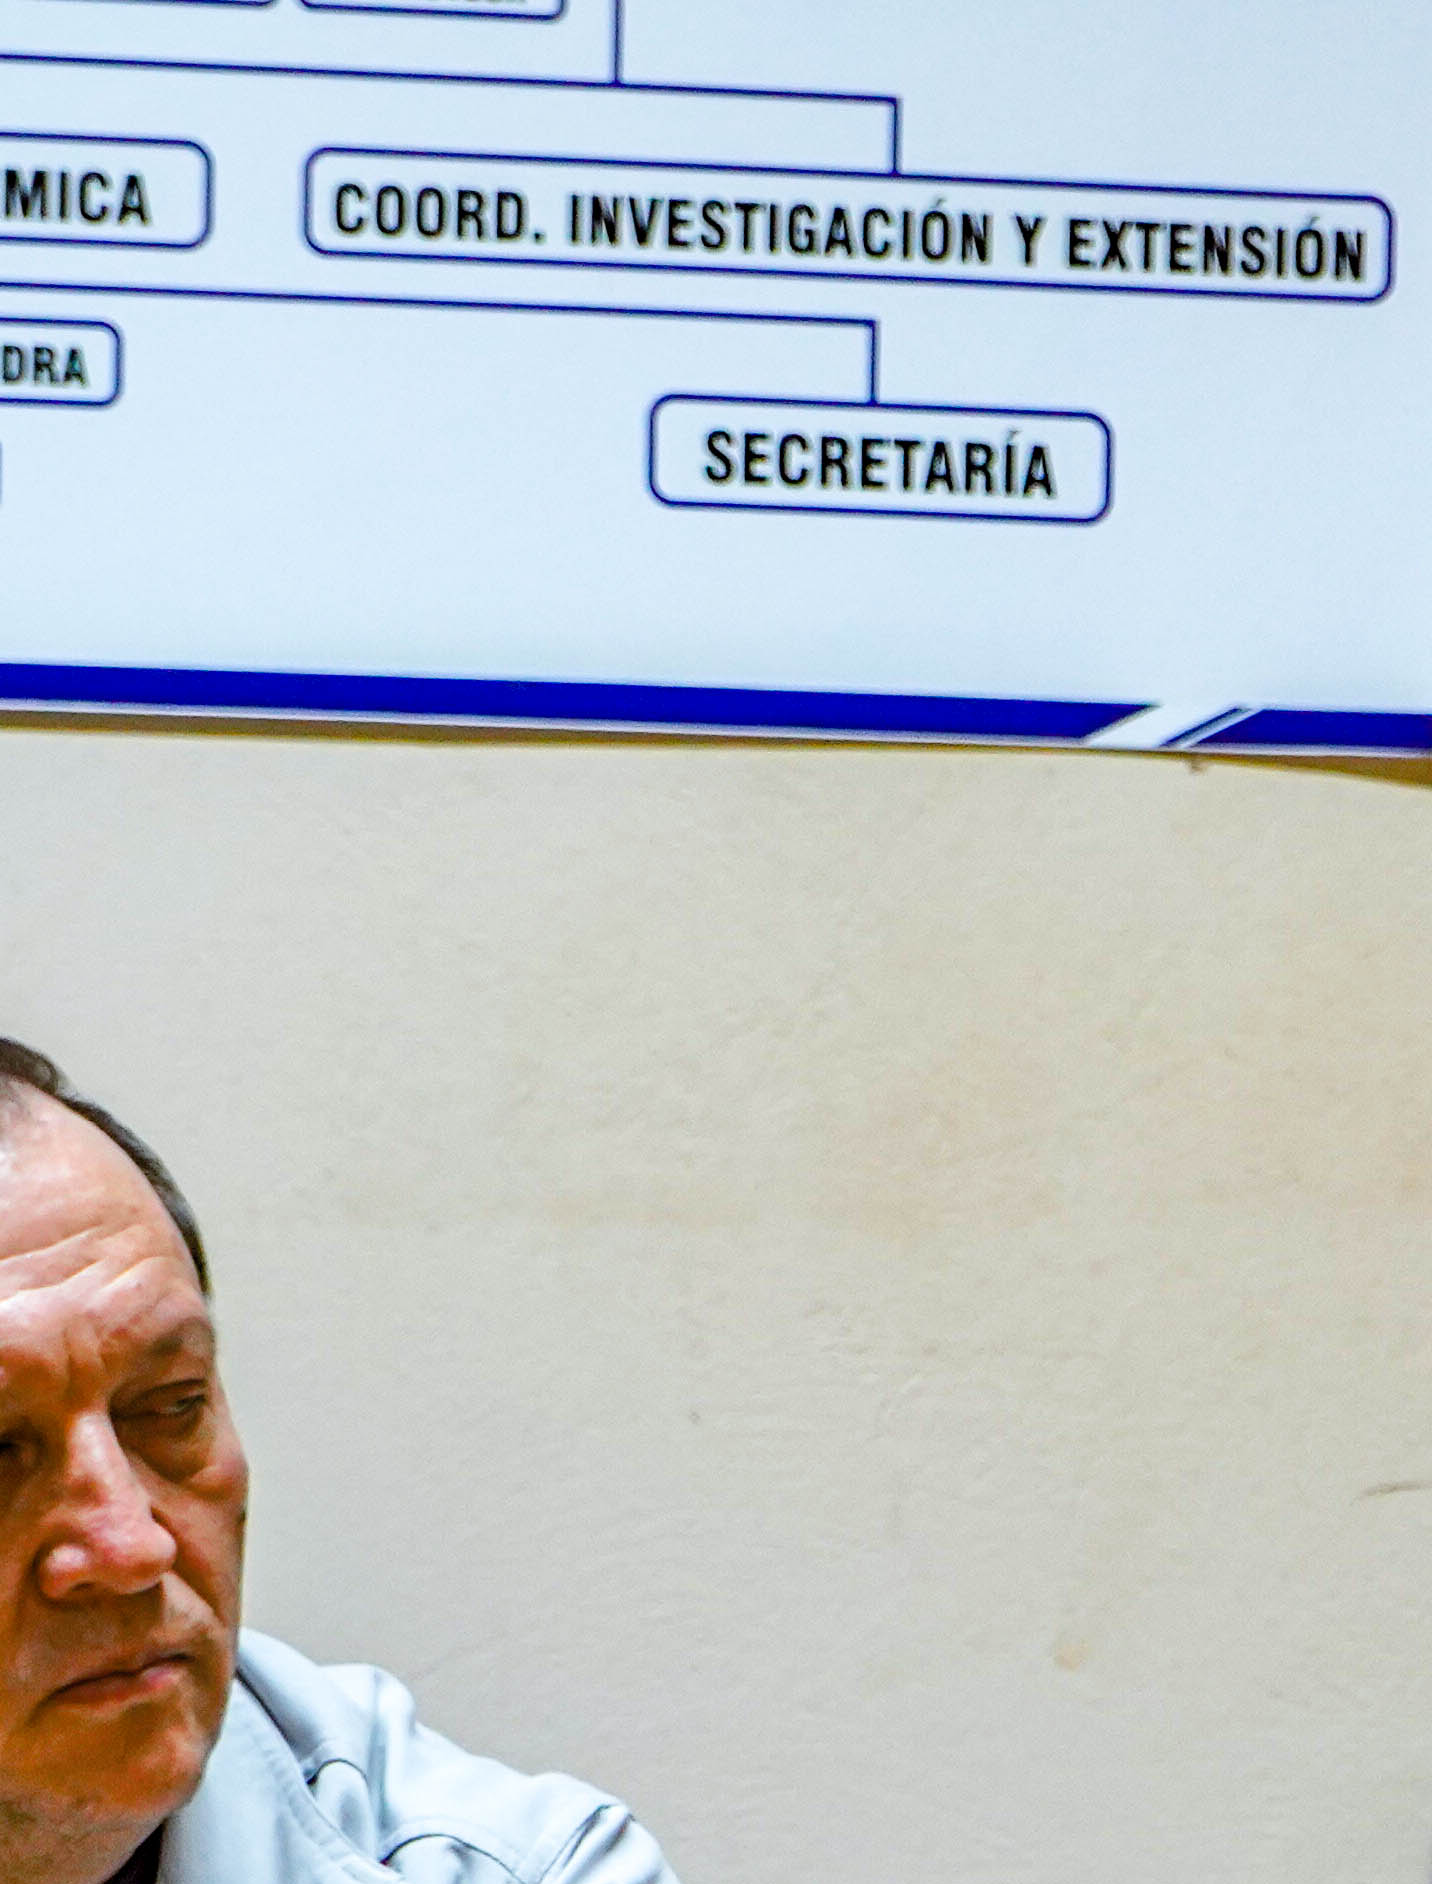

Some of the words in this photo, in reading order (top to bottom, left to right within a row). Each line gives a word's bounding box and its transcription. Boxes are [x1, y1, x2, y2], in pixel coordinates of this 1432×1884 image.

[334, 182, 544, 244] COORD.
[569, 193, 991, 264] INVESTIGACIÓN
[1014, 214, 1046, 267] Y
[1067, 214, 1365, 283] EXTENSIÓN
[704, 428, 1056, 499] SECRETARÍA
